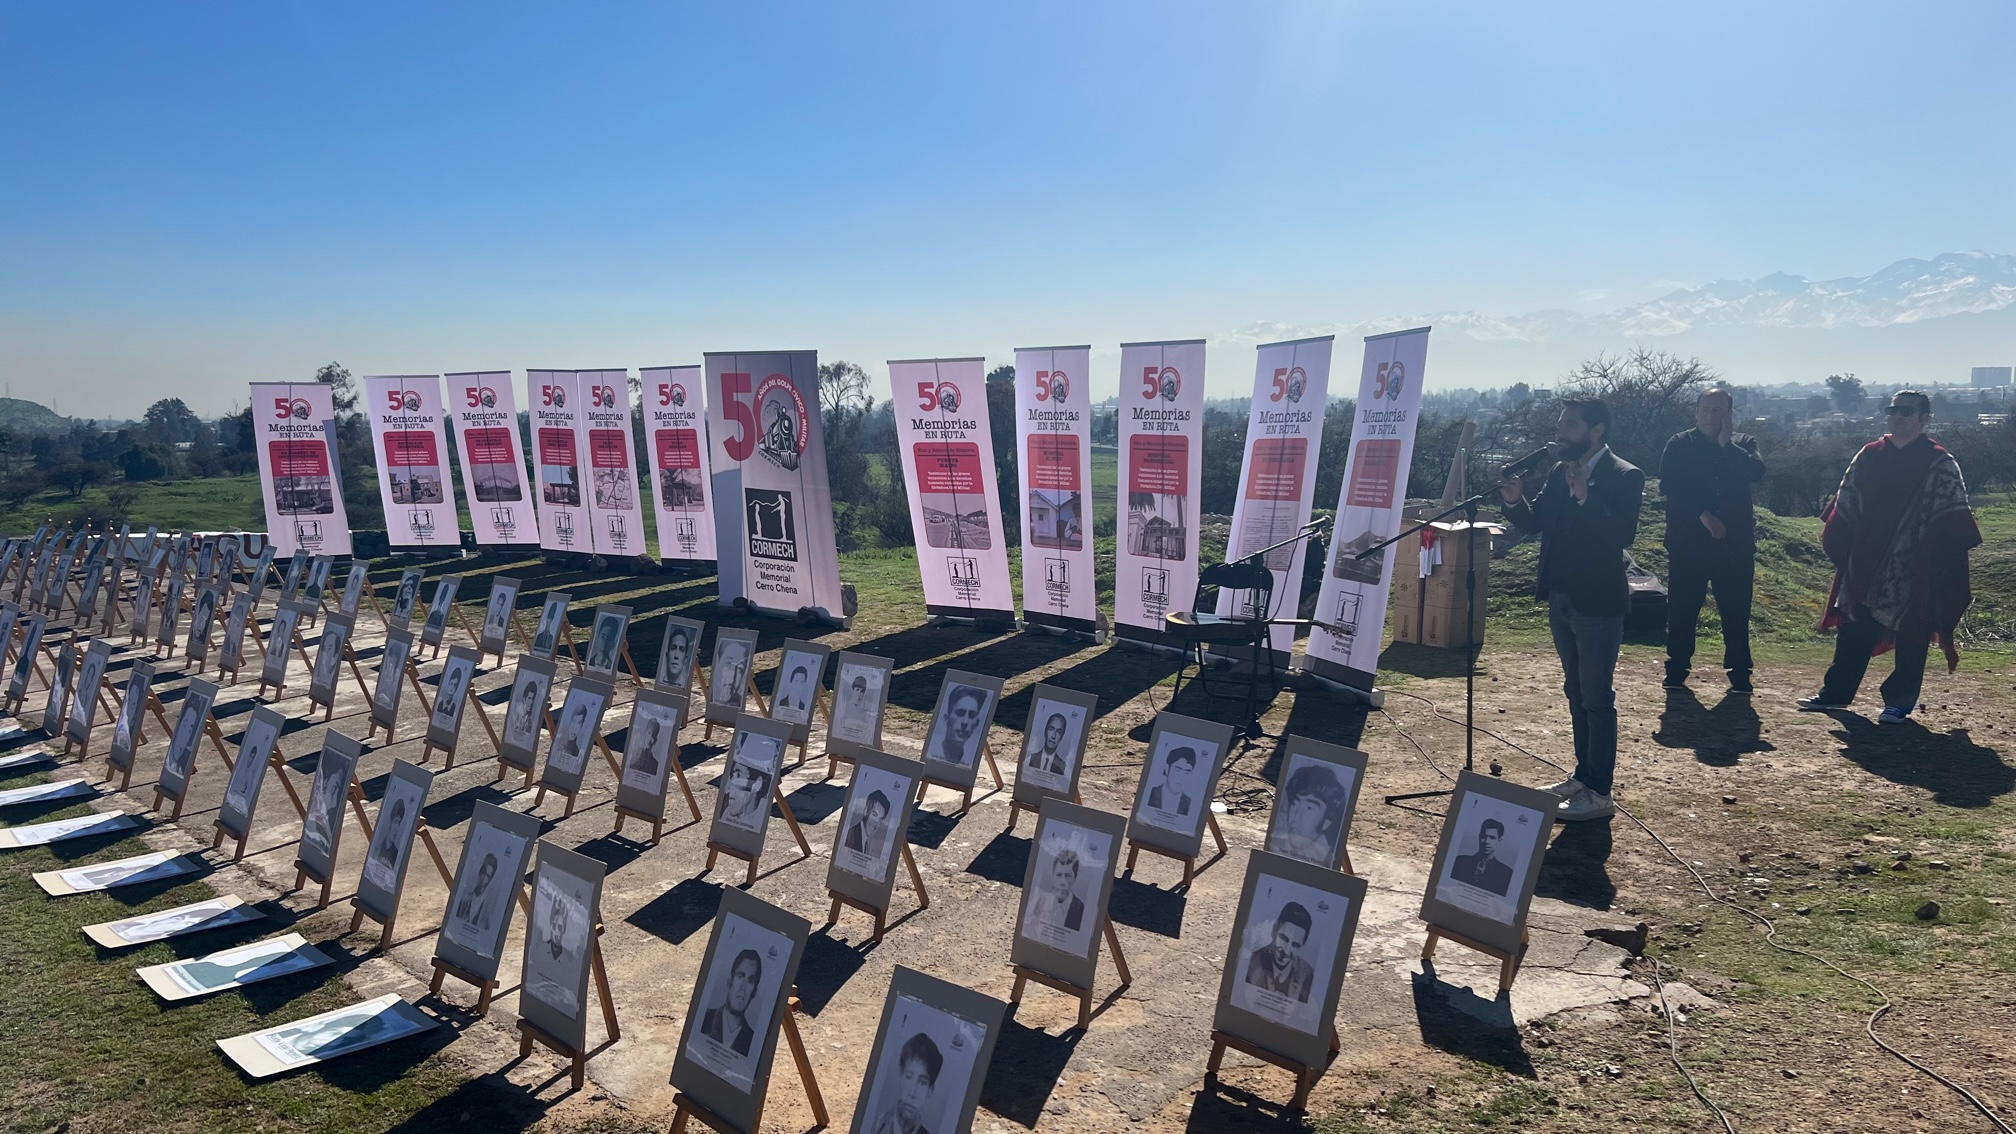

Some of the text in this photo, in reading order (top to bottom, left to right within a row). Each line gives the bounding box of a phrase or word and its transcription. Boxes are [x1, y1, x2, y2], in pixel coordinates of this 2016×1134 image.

[462, 411, 508, 421] Memorias
[537, 411, 574, 421] Memorias
[588, 411, 624, 421] Memorias
[654, 411, 696, 421] Memorias
[757, 383, 769, 401] AÑOS
[768, 379, 777, 387] DEL
[777, 379, 793, 392] GOLPE
[791, 390, 805, 414] CÍVICO
[799, 418, 808, 448] MILITAR
[1028, 408, 1080, 421] Memorias
[1132, 407, 1191, 421] Memorias
[1258, 410, 1313, 424] Memorias
[1362, 409, 1407, 424] Memorias
[383, 415, 434, 424] Memorias
[720, 372, 809, 468] 50
[911, 418, 977, 430] Memorias
[268, 424, 325, 432] Memorias
[1037, 422, 1071, 431] EN RUTA
[1142, 421, 1180, 432] EN RUTA
[1265, 424, 1301, 435] EN RUTA
[1367, 425, 1397, 435] EN RUTA
[925, 431, 967, 439] EN RUTA
[757, 450, 781, 469] CORMECH
[751, 540, 795, 558] CORMECH
[753, 560, 795, 573] Corporación
[760, 571, 791, 583] Memorial
[755, 581, 798, 595] Cerro Chena
[1047, 582, 1069, 590] CORMECH
